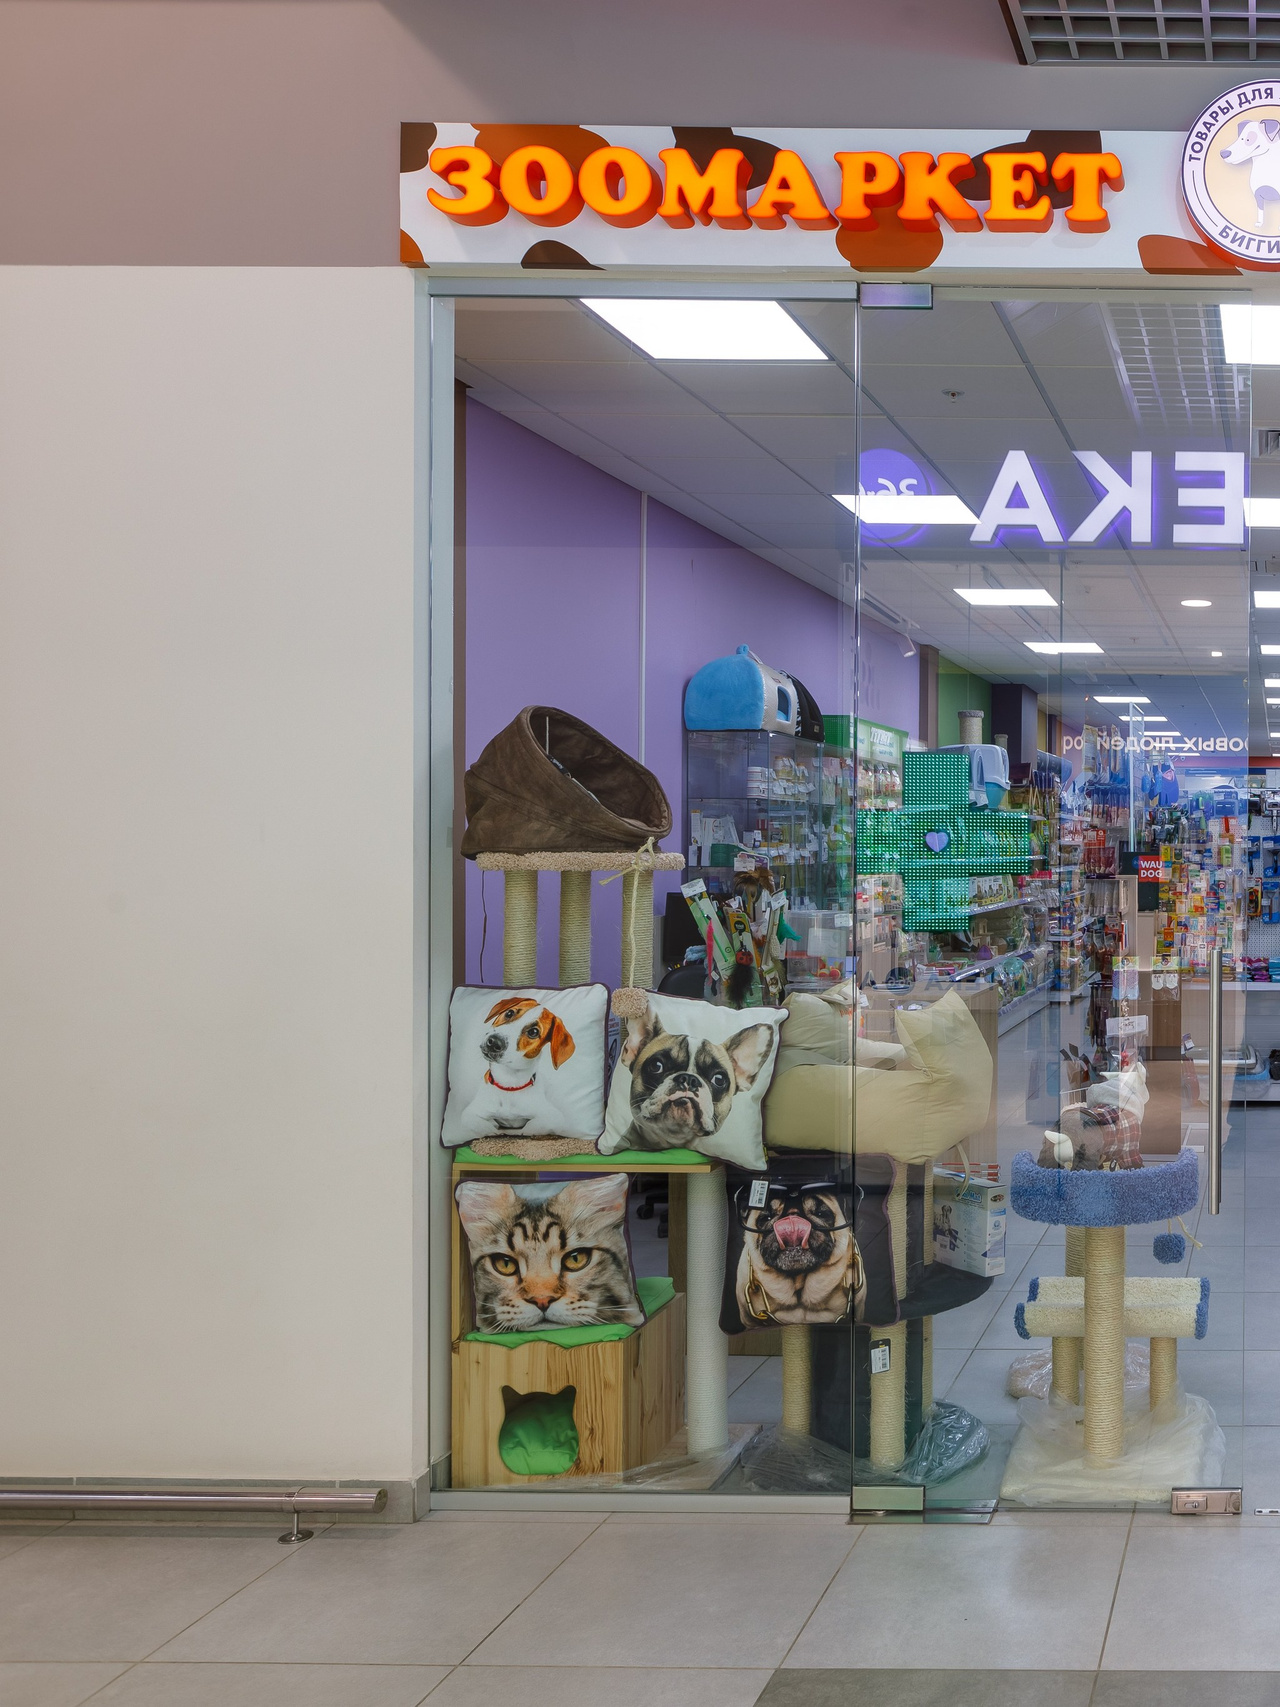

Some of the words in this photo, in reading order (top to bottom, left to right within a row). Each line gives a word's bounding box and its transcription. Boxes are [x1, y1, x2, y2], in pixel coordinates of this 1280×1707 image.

[1188, 99, 1235, 163] ТОВАРЫ
[1236, 87, 1274, 108] ДЛЯ
[427, 145, 1124, 232] ЗООМАРКЕТ
[1217, 225, 1280, 254] БИГГИ
[1140, 860, 1163, 869] WAU
[1140, 869, 1163, 878] DOG
